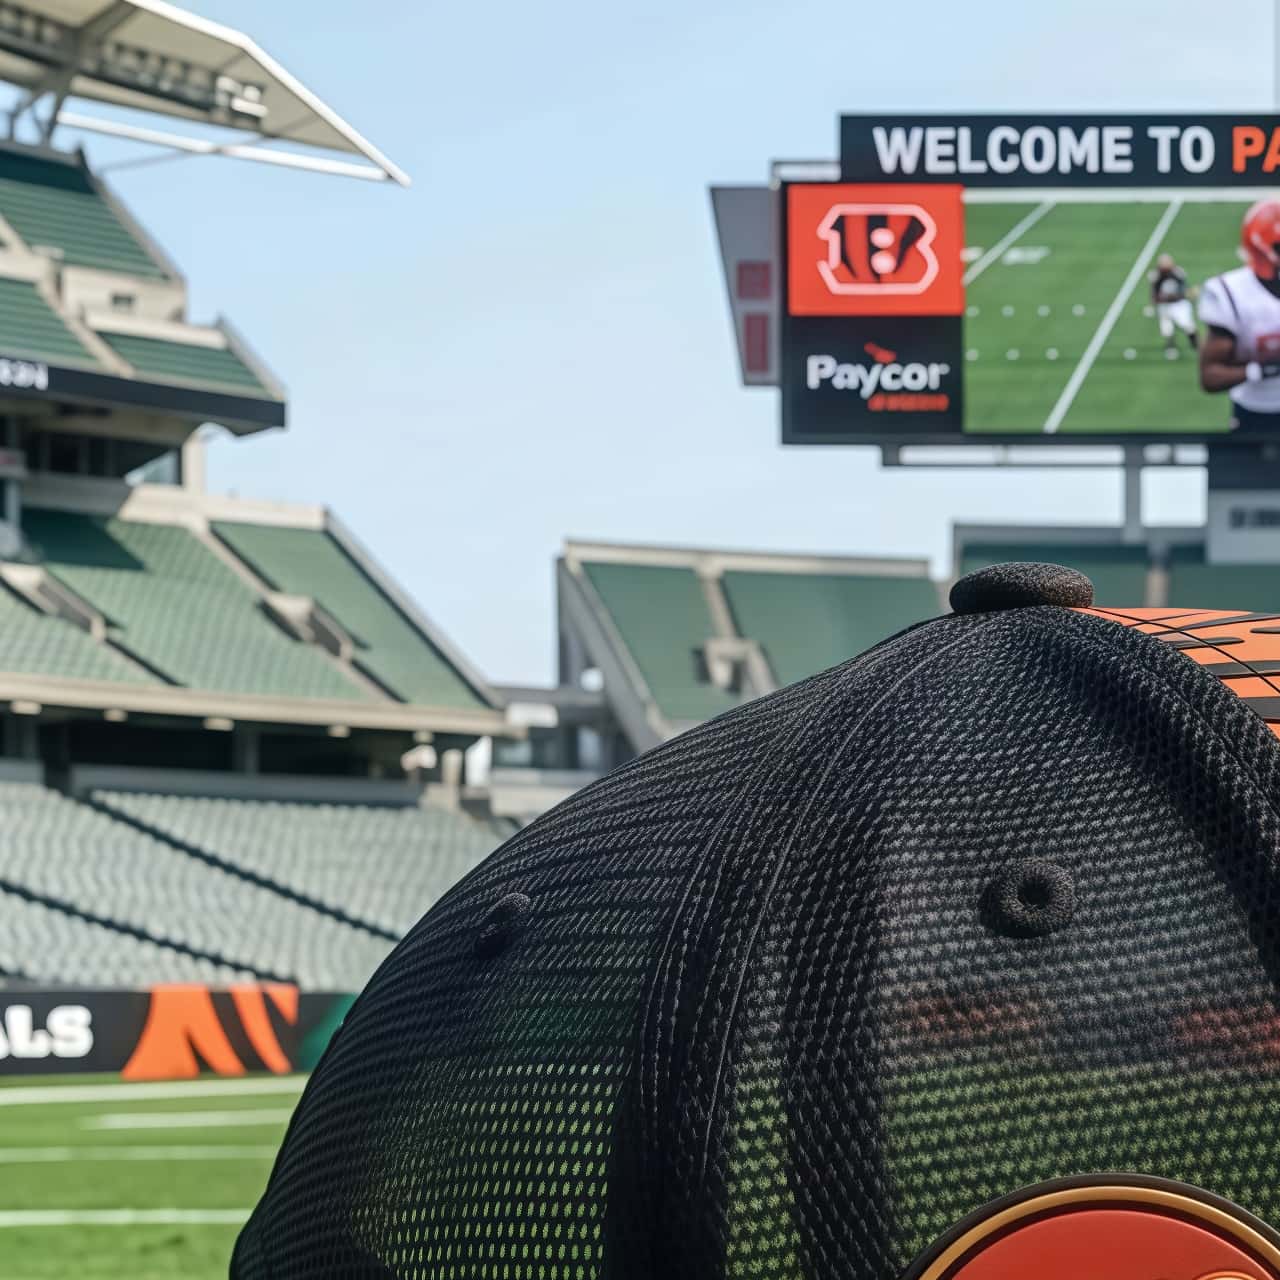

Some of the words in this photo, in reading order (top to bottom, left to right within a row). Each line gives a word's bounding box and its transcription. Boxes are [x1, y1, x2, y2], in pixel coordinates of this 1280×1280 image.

[872, 126, 1134, 174] WELCOME
[1147, 126, 1216, 174] TO
[807, 354, 950, 399] Paycor
[0, 1004, 94, 1058] LS
